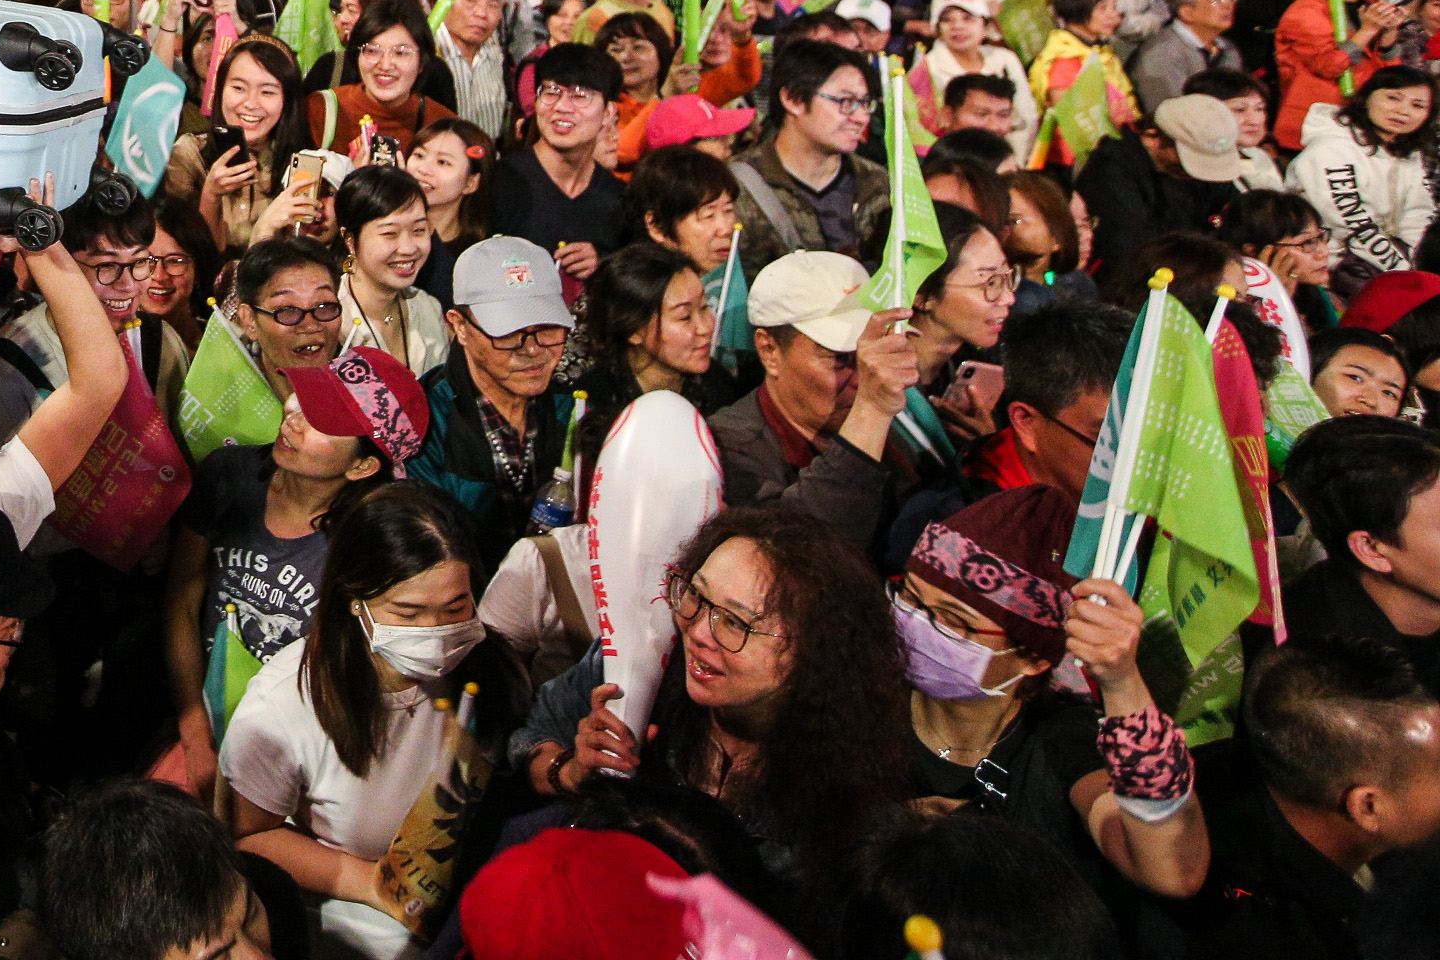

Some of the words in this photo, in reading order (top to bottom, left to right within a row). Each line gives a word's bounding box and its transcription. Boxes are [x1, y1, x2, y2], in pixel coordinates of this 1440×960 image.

[340, 361, 366, 382] 18
[213, 546, 269, 573] THIS
[277, 564, 320, 617] GIRL
[241, 573, 271, 599] RUNS
[269, 588, 287, 608] ON
[965, 562, 1001, 590] 18
